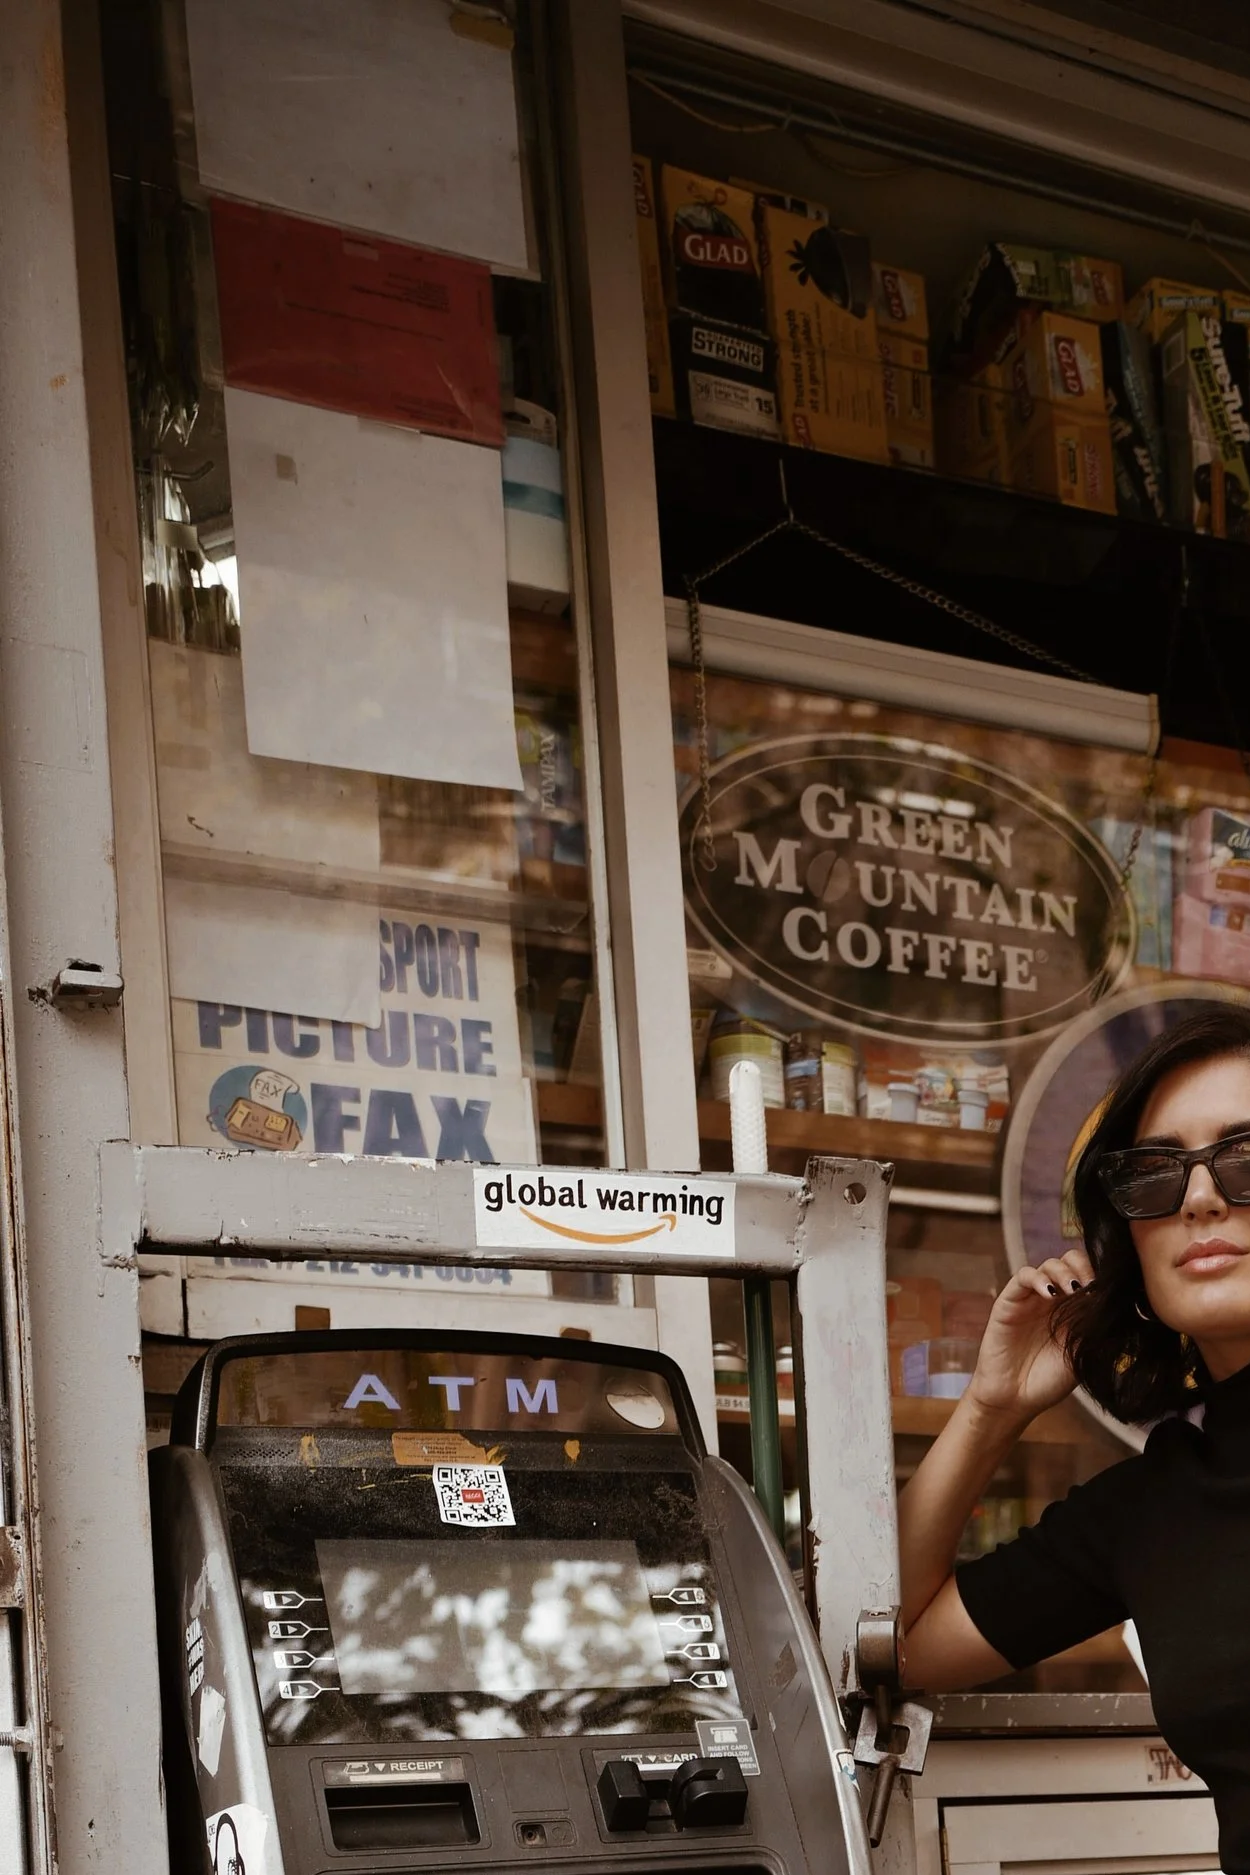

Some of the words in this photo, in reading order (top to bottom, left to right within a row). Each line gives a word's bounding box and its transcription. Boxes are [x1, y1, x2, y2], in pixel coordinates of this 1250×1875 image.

[684, 234, 748, 264] GLAD
[694, 331, 761, 367] STRONG
[1057, 340, 1082, 394] GLAD
[801, 784, 1014, 868] GREEN
[782, 907, 1039, 991] COFFEE
[310, 1083, 495, 1163] FAX
[484, 1175, 587, 1213] global
[596, 1186, 725, 1226] warming
[271, 1624, 280, 1636] 2
[282, 1684, 290, 1696] 4
[664, 1753, 698, 1764] CARD
[707, 1744, 729, 1753] INSERT
[730, 1743, 748, 1752] CARD
[709, 1751, 722, 1759] AND
[723, 1749, 750, 1758] FOLLOW
[390, 1760, 444, 1774] RECEIPT
